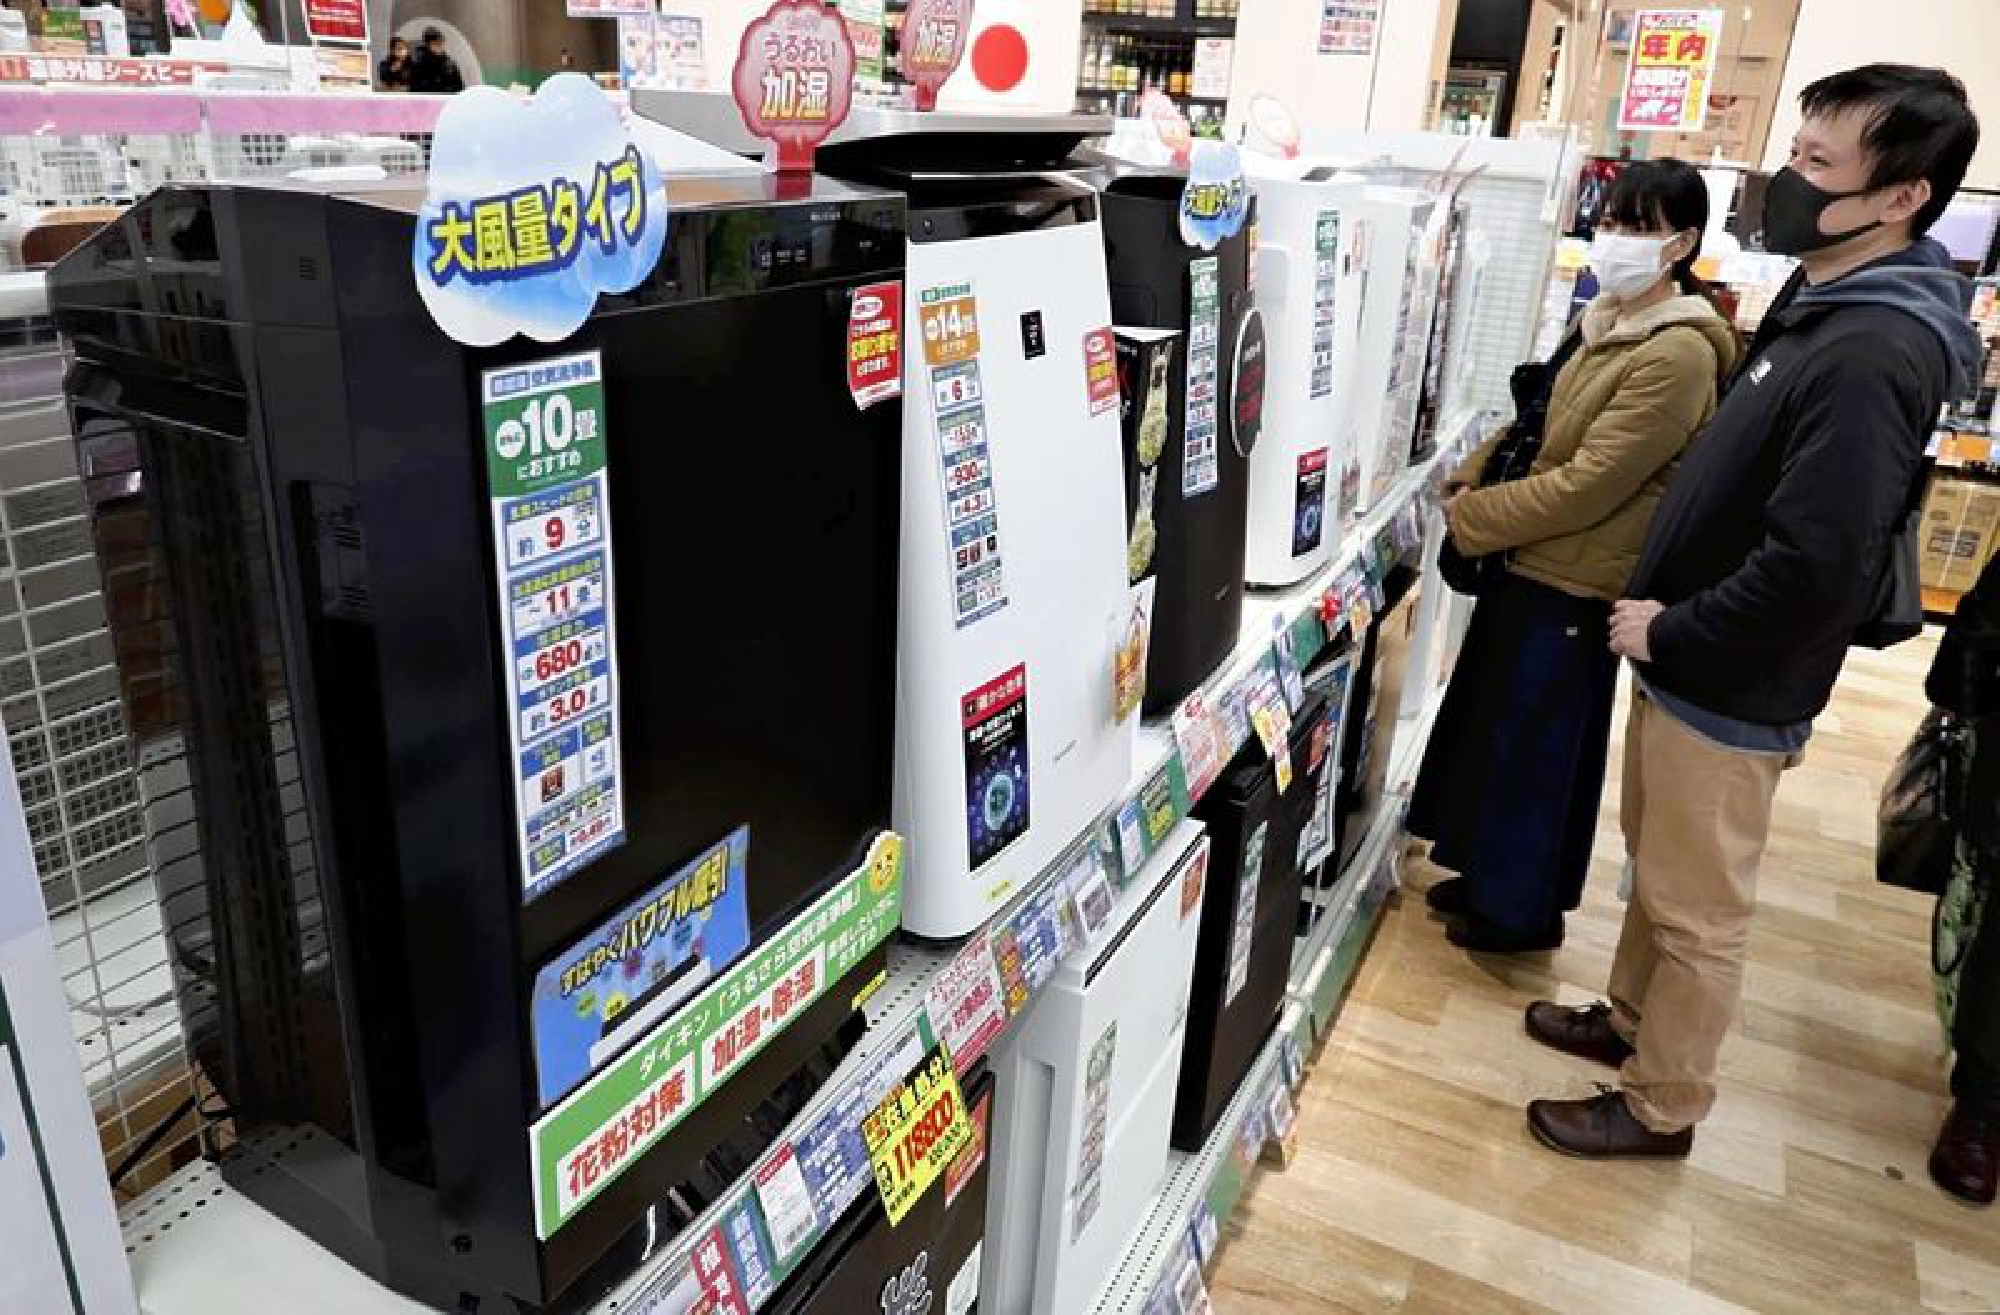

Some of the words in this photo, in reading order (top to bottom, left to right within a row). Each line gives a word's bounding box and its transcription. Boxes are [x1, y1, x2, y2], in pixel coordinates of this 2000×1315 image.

[764, 32, 836, 62] うるおい
[1641, 32, 1707, 60] 年内
[760, 64, 830, 120] 加湿
[430, 144, 645, 284] 大風量タイプ
[535, 639, 582, 681] 680
[550, 688, 587, 723] 3.0
[640, 1008, 712, 1081] ダイキン
[568, 1068, 687, 1199] 花粉対策
